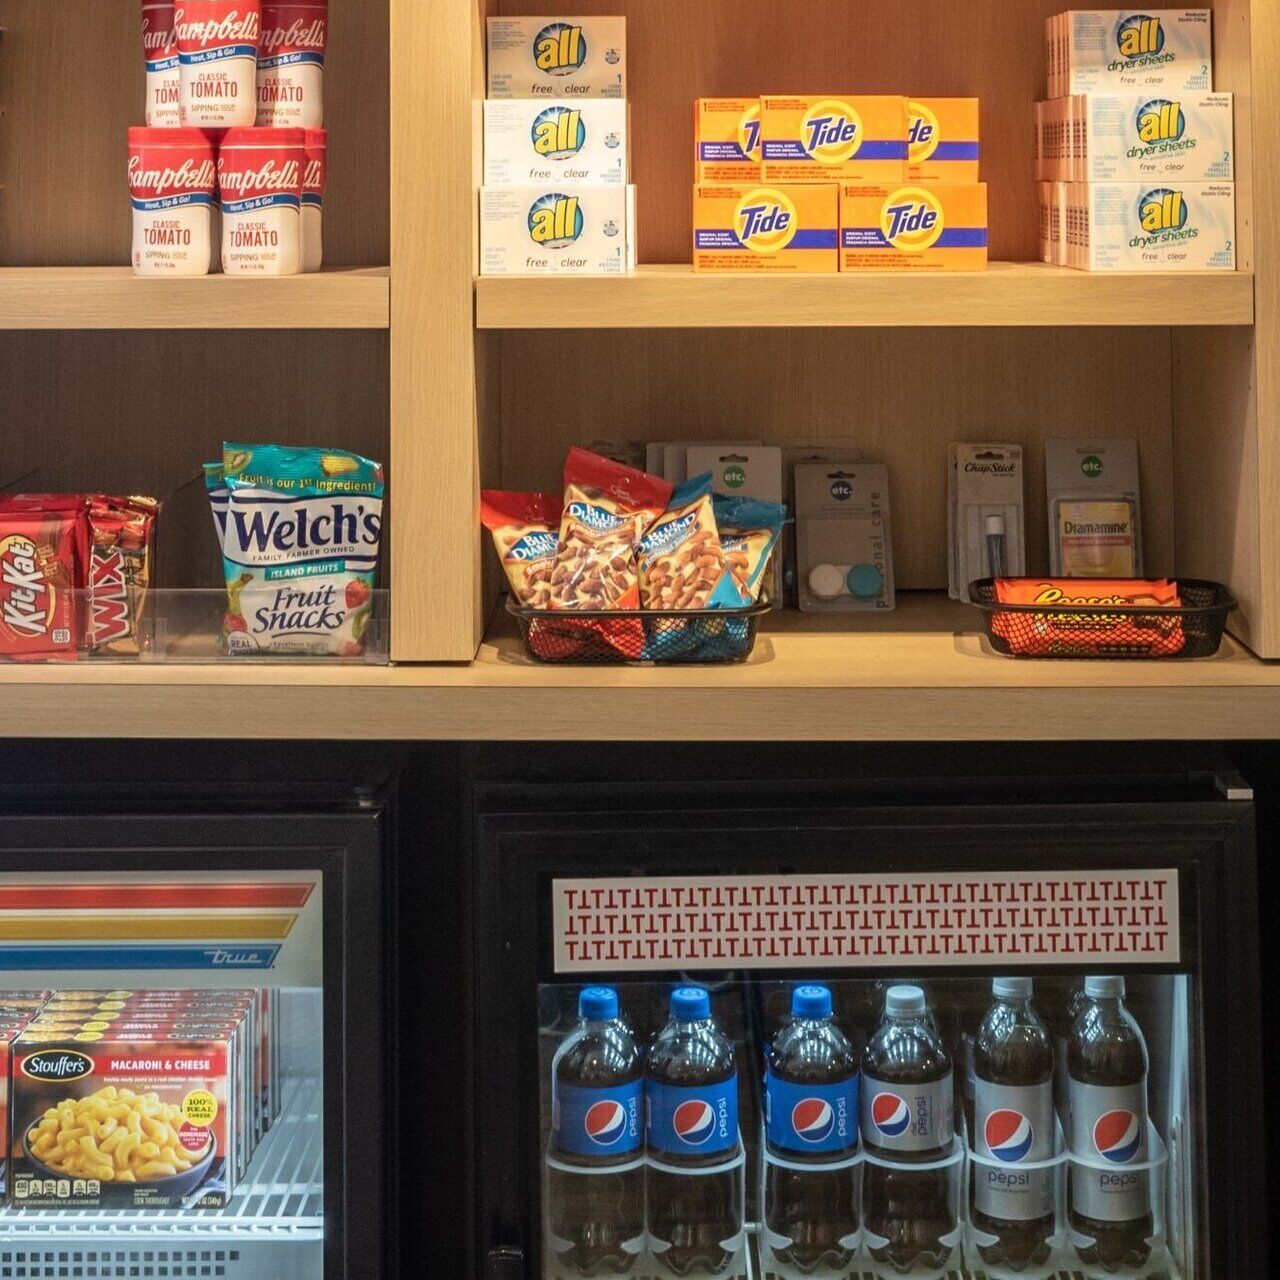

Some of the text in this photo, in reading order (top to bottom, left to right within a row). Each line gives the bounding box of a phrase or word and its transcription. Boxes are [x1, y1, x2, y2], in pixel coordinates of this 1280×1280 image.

[1119, 17, 1161, 56] all
[206, 51, 217, 60] Sip
[223, 47, 236, 56] Go!
[535, 25, 583, 71] all
[1107, 51, 1176, 74] dryer sheets
[198, 73, 228, 81] CLASSIC
[1120, 75, 1164, 84] free clear
[155, 87, 180, 104] TOM
[190, 81, 238, 98] TOMATO
[257, 86, 303, 102] TOMATO
[531, 84, 553, 95] free
[564, 84, 590, 95] clear
[909, 118, 934, 144] de
[1139, 101, 1181, 143] all
[533, 109, 581, 154] all
[805, 116, 857, 153] Tide
[1126, 138, 1196, 159] dryer sheets
[529, 168, 590, 179] free clear
[1139, 163, 1185, 171] free clear
[530, 196, 580, 244] all
[1141, 191, 1183, 232] all
[740, 205, 791, 241] Tide
[886, 204, 937, 242] Tide
[144, 228, 191, 246] TOMATO
[229, 230, 278, 247] TOMATO
[1128, 227, 1199, 249] dryer sheets
[525, 257, 587, 268] free clear
[1141, 252, 1187, 261] free clear
[964, 460, 1016, 475] ChapStick
[1082, 461, 1104, 471] etc.
[238, 472, 263, 484] Fruit
[266, 476, 274, 487] is
[276, 479, 295, 488] our
[723, 471, 746, 482] etc.
[831, 486, 853, 496] etc.
[586, 503, 616, 523] BLUE
[870, 491, 881, 527] care
[230, 504, 382, 553] Welch's
[1064, 520, 1128, 535] Dramamine
[252, 545, 355, 562] FAMILY FARMER OWNED
[511, 540, 558, 562] DIAMO
[270, 563, 339, 578] ISLAND FRUITS
[272, 584, 336, 612] Fruit
[252, 606, 346, 634] Snacks
[230, 639, 252, 649] REAL
[29, 1057, 85, 1076] Stouffer's
[111, 1060, 211, 1070] MACARONI & CHEESE
[628, 1096, 638, 1138] pepsi
[718, 1096, 728, 1138] pepsi
[836, 1096, 847, 1138] pepsi
[916, 1095, 929, 1138] pepsi
[987, 1170, 1030, 1188] pepsi
